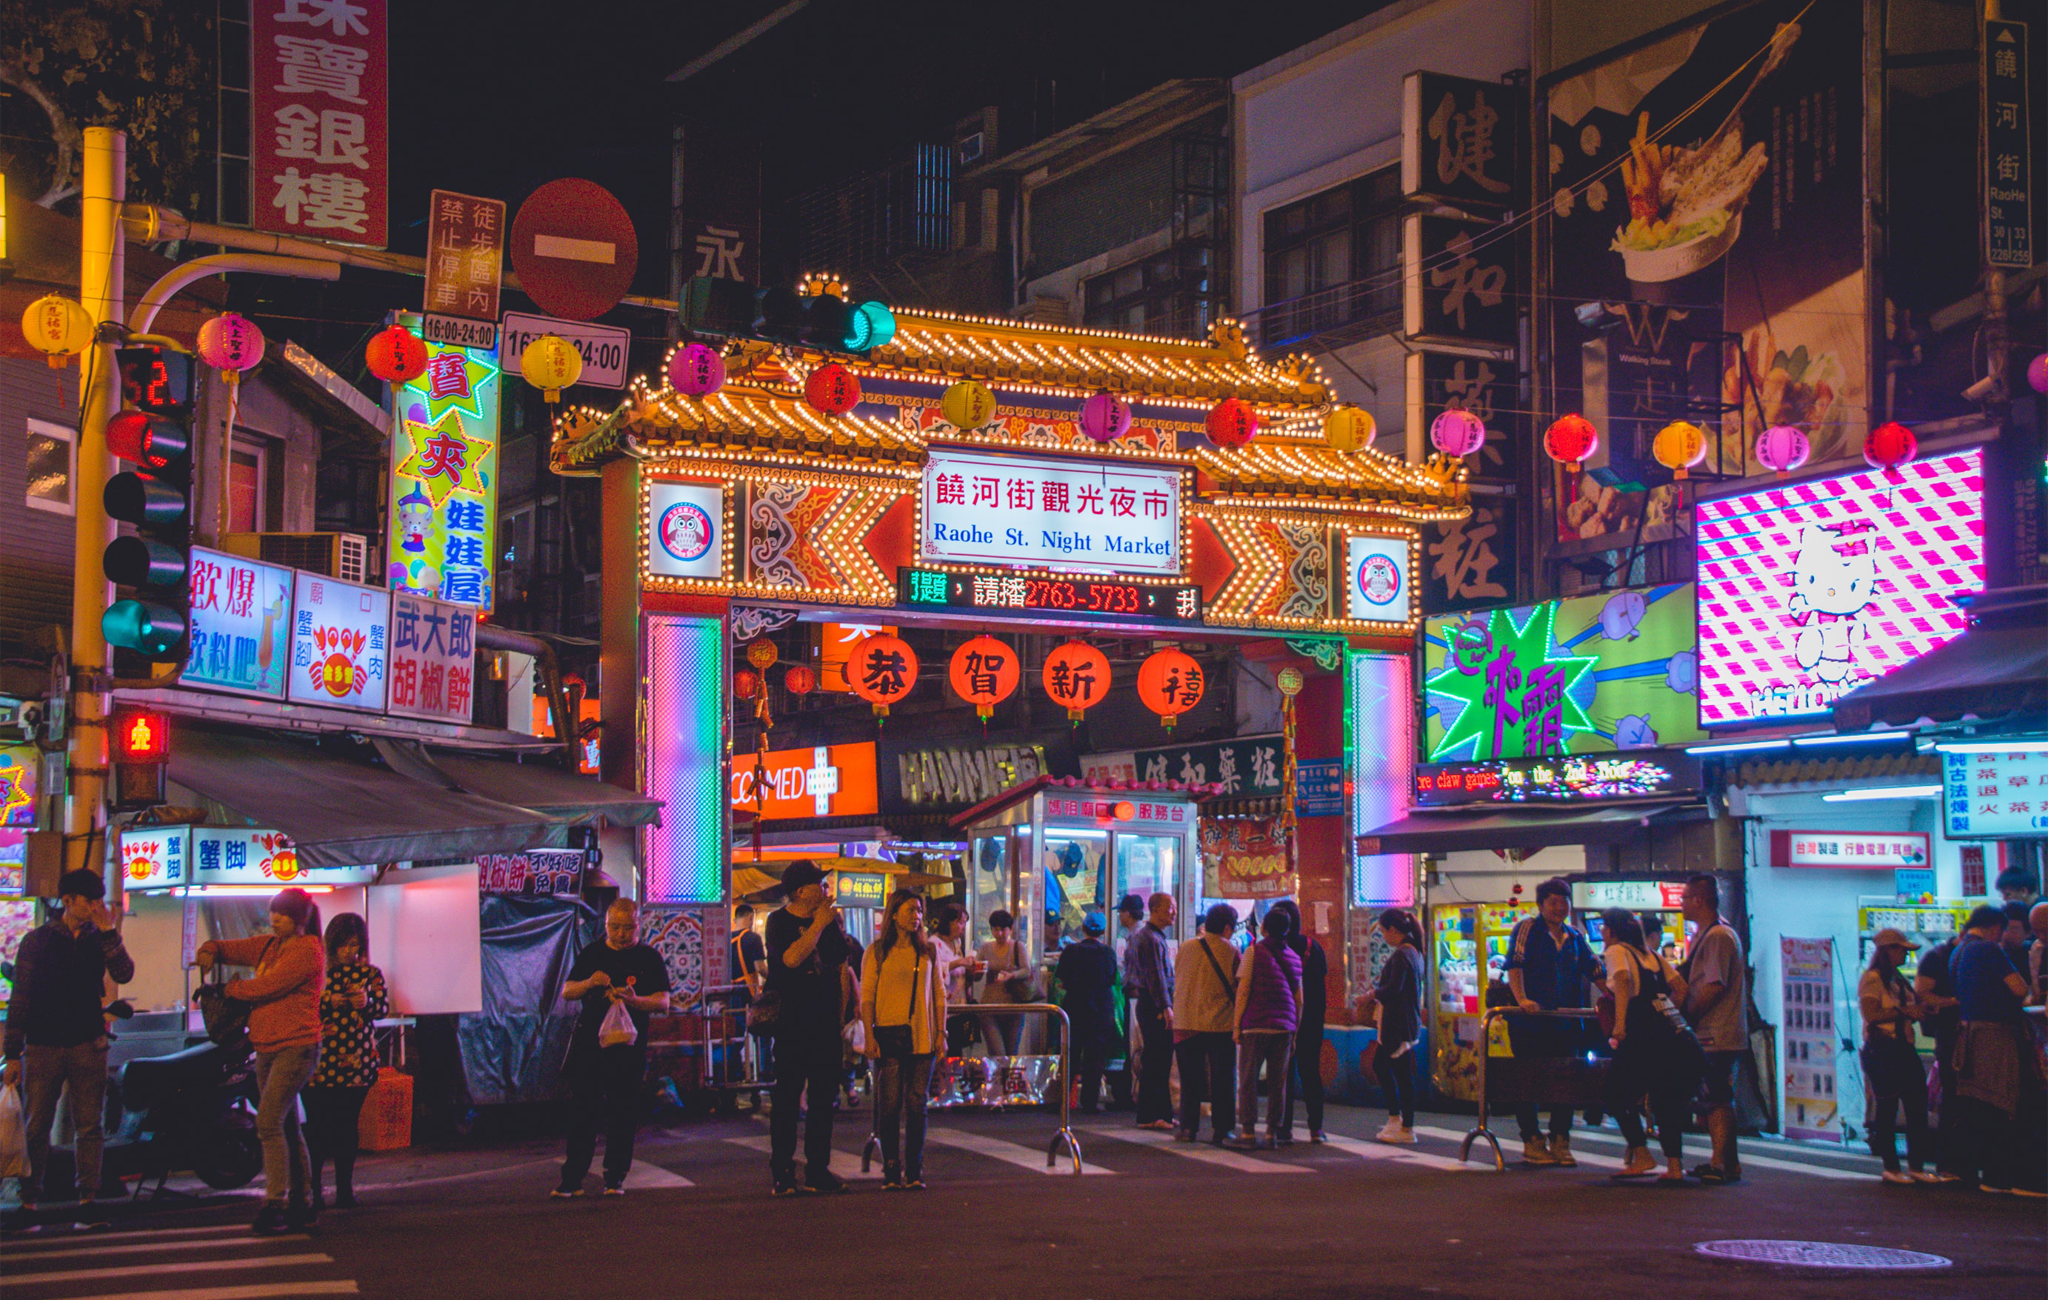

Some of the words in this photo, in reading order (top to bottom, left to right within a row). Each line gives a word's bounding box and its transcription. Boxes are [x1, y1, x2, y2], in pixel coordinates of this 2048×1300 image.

[1994, 48, 2020, 183] 饒河街
[1990, 187, 2027, 203] RaoHe
[1990, 207, 2005, 221] St.
[434, 199, 464, 306] 禁止停車
[467, 205, 495, 312] 徒步區內
[428, 319, 492, 345] 16:00-24:00
[1618, 353, 1650, 366] Walking
[935, 471, 1170, 521] 饒河街觀光夜市
[443, 499, 485, 606] 娃娃屋
[933, 522, 994, 545] Raohe
[1005, 528, 1029, 547] St.
[1041, 530, 1092, 553] Night
[1104, 534, 1171, 556] Market
[395, 602, 472, 660] 武大郎
[393, 654, 470, 716] 胡椒餅
[863, 648, 908, 695] 恭
[964, 650, 1004, 696] 賀
[1052, 660, 1096, 700] 新
[731, 766, 805, 805] COMED
[1436, 772, 1461, 788] claw
[1465, 770, 1498, 791] games
[1533, 763, 1554, 784] the
[1138, 803, 1184, 822] 服務台
[531, 853, 581, 874] 不好吃
